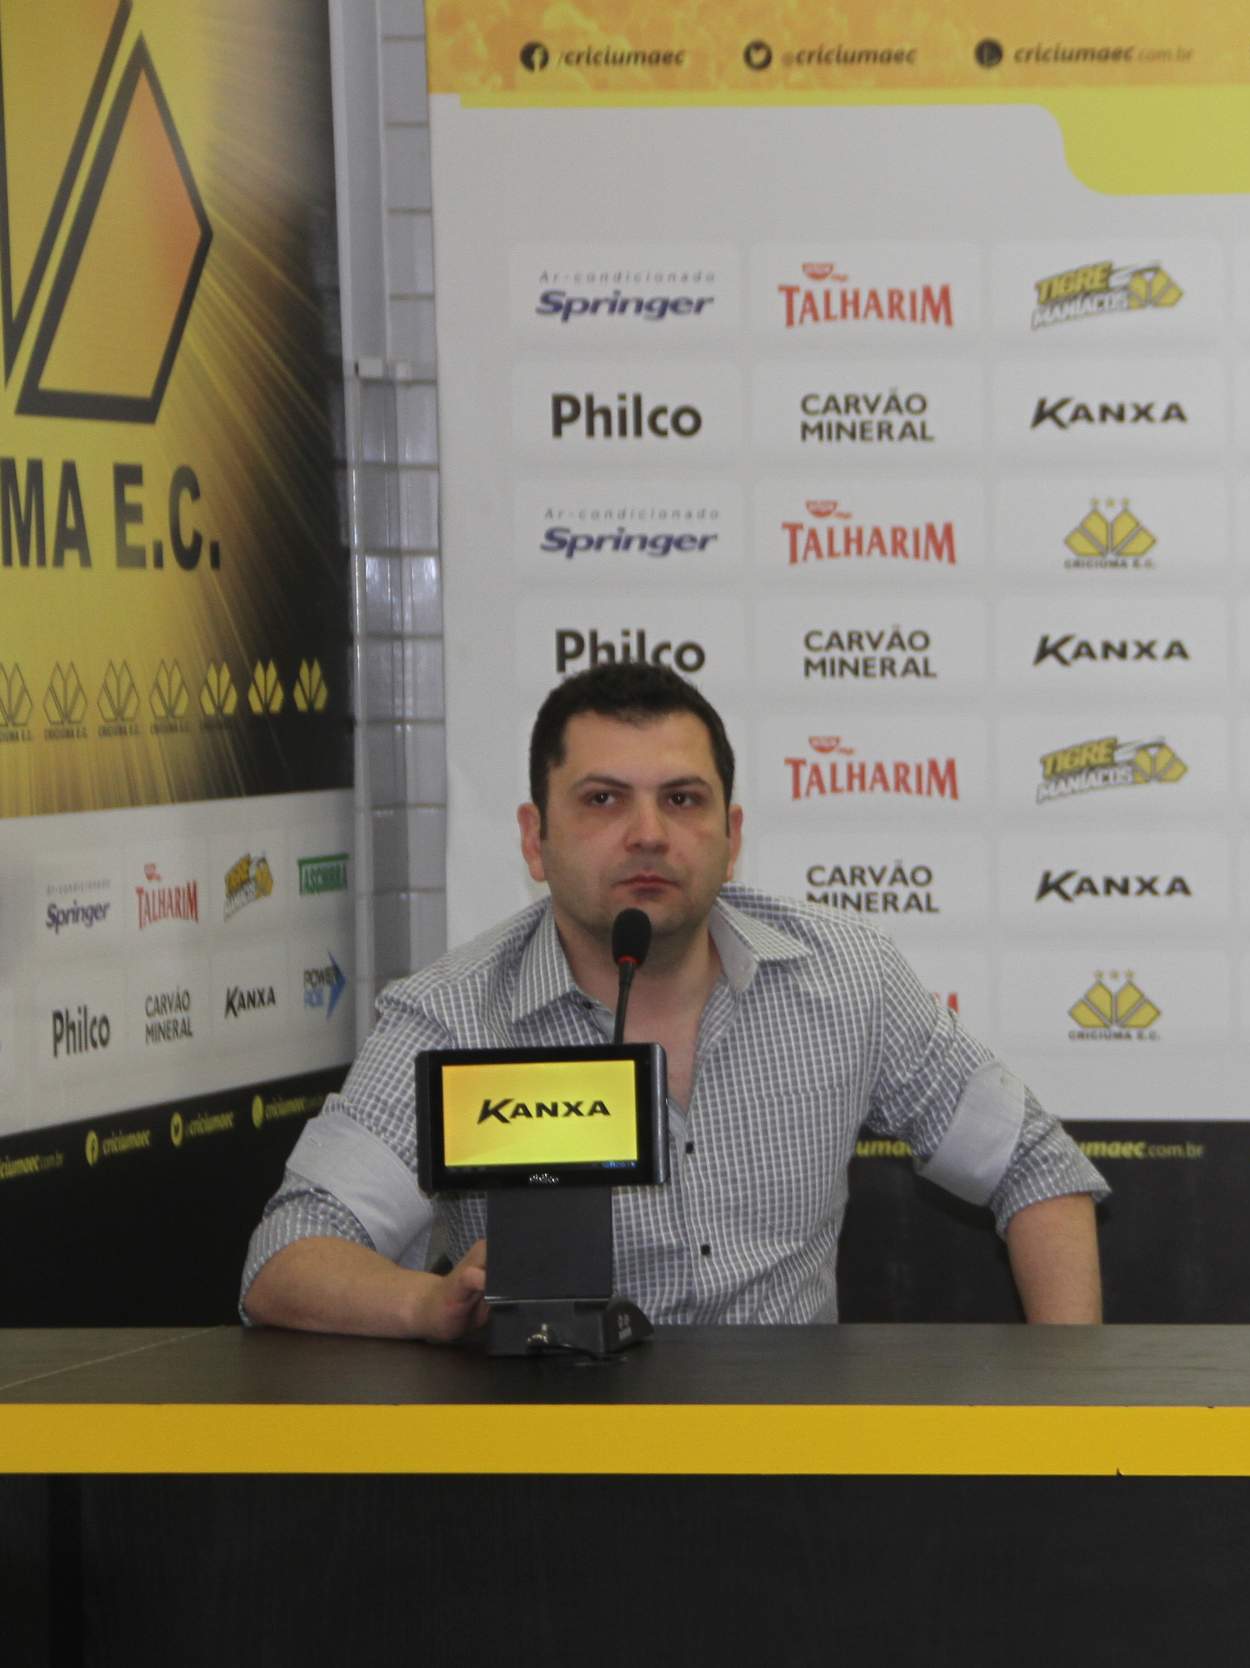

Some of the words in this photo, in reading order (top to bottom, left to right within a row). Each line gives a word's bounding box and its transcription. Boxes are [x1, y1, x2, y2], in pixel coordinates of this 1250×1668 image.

[536, 290, 714, 323] Springer
[778, 284, 953, 328] TALHARIM
[552, 393, 702, 439] Philco
[800, 385, 928, 416] CARVÃO
[1031, 398, 1187, 430] KANXA
[801, 420, 934, 442] MINERAL
[113, 461, 221, 572] E.C.
[541, 527, 717, 560] Springer
[782, 521, 956, 565] TALHARIM
[555, 628, 706, 673] Philco
[804, 622, 931, 653] CARVÃO
[1033, 634, 1189, 667] KANXA
[804, 657, 936, 678] MINERAL
[784, 758, 959, 800] TALHARIM
[806, 858, 933, 888] CARVÃO
[1035, 870, 1192, 903] KANXA
[46, 900, 110, 934] Springer
[136, 879, 199, 929] TALHARIM
[805, 891, 940, 913] MINERAL
[225, 986, 276, 1018] KANXA
[52, 1005, 110, 1058] Philco
[144, 1017, 194, 1046] MINERAL
[477, 1098, 610, 1124] KANXA
